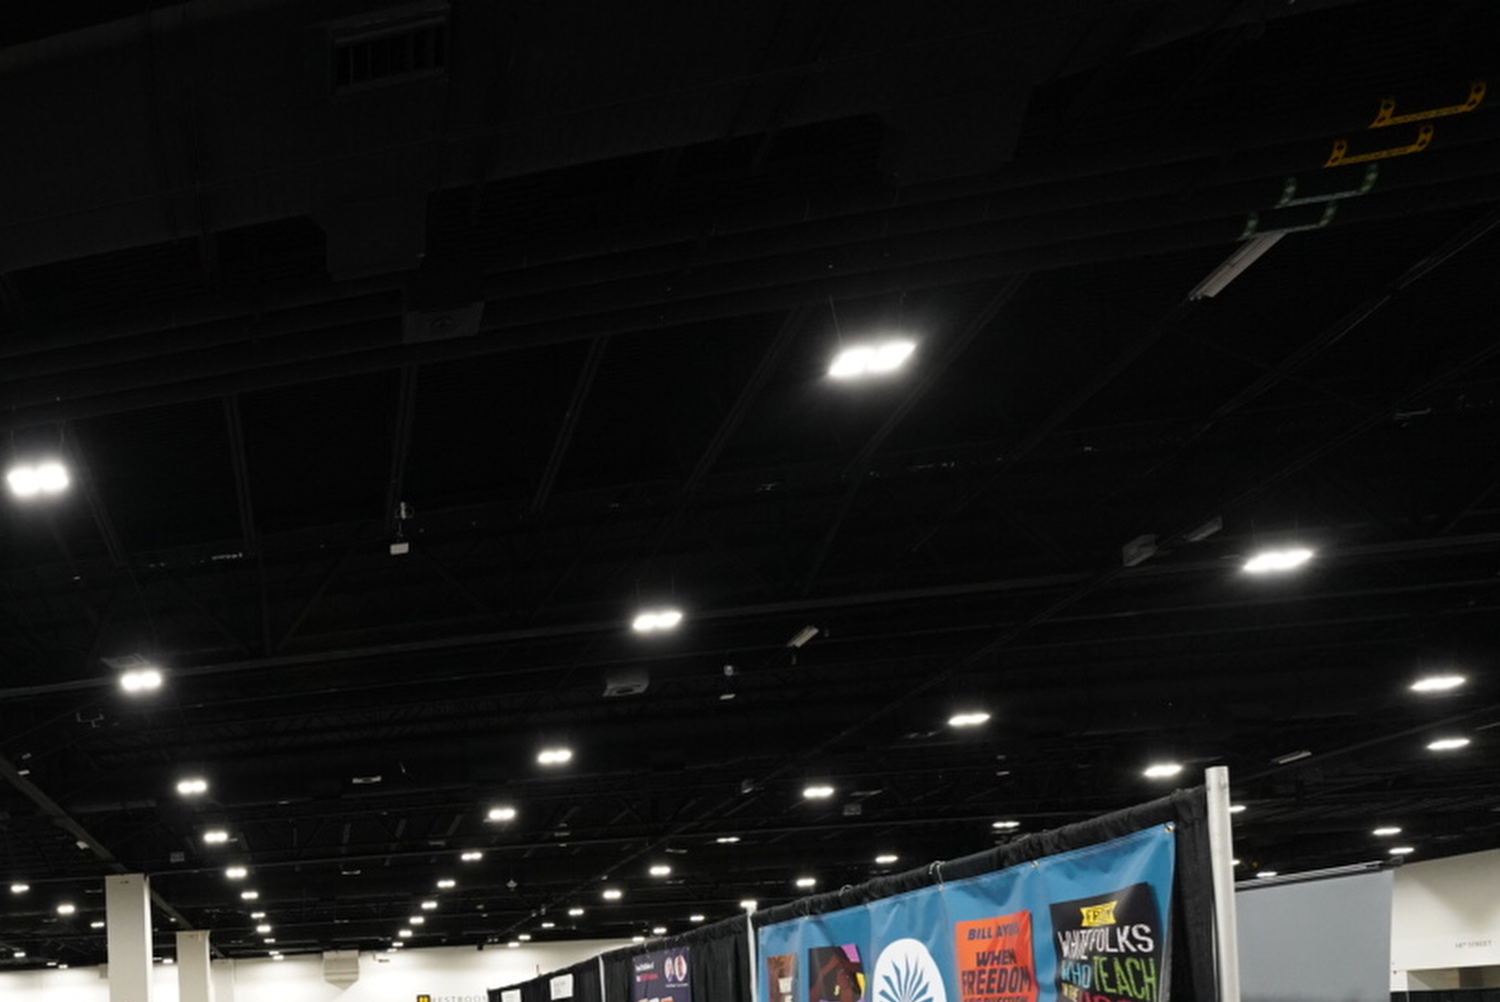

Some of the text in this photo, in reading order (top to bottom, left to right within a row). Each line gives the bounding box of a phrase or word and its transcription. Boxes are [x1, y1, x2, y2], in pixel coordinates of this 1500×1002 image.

[968, 927, 992, 940] BILL
[1089, 923, 1155, 953] FOLKS
[975, 948, 1017, 968] WHEN
[961, 965, 1032, 996] FREEDOM
[1061, 961, 1092, 990] WHO
